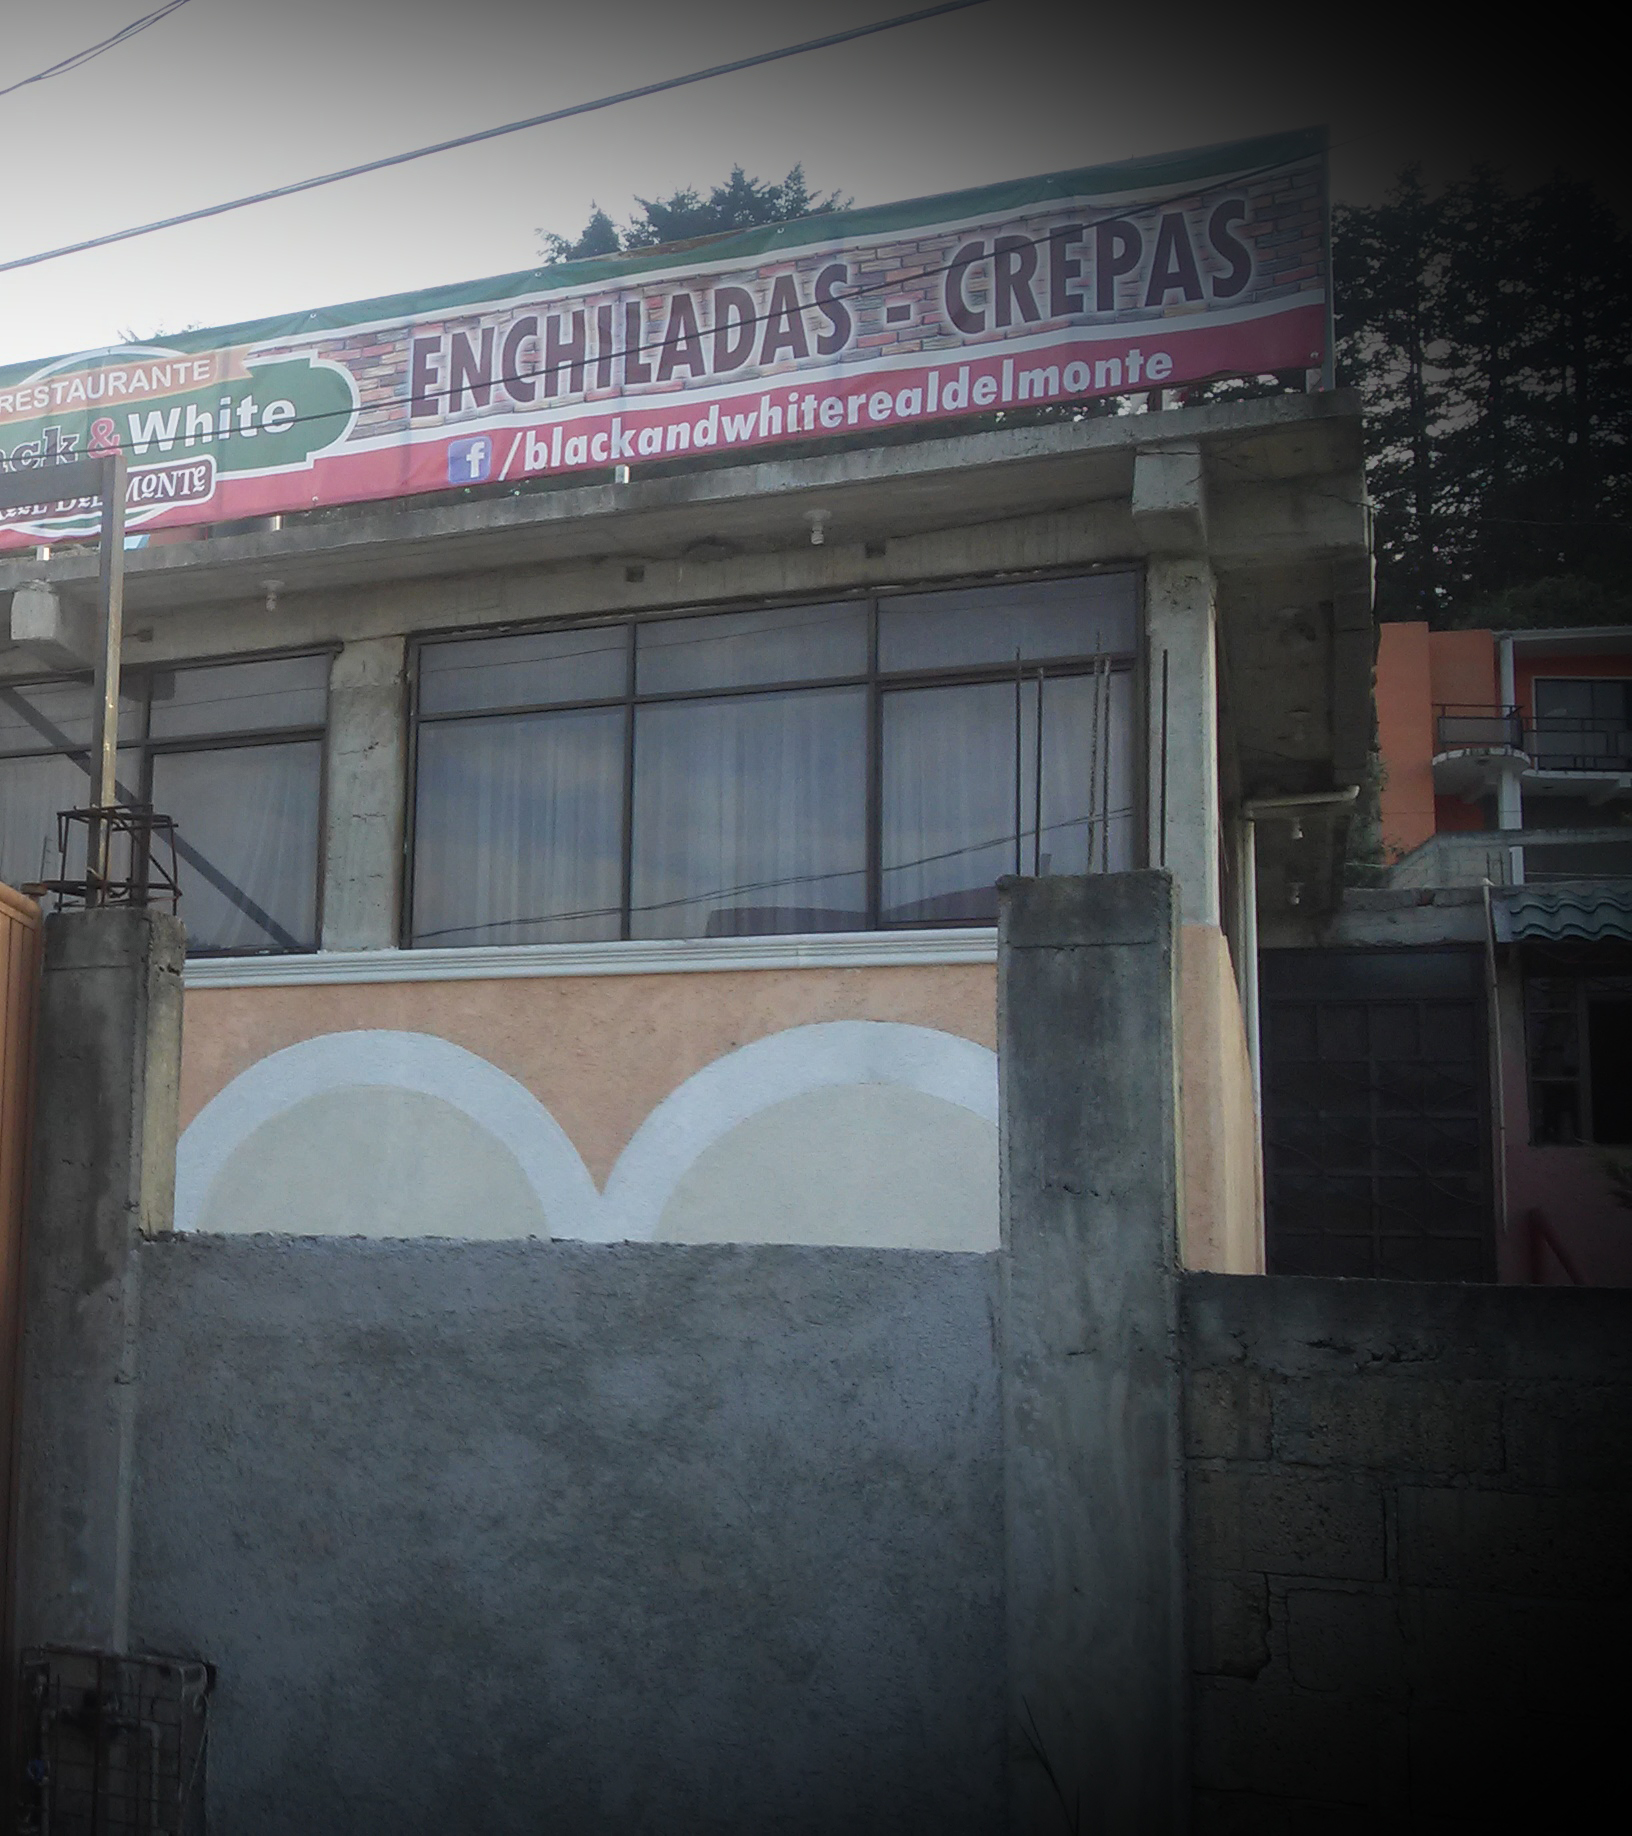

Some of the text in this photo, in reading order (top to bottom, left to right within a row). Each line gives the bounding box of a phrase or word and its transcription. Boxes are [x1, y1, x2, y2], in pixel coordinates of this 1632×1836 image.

[411, 264, 853, 418] ENCHILADAS
[945, 199, 1253, 334] CREPAS
[87, 417, 123, 459] &
[128, 396, 296, 455] White
[499, 348, 1173, 481] /blackandwhiterealdelmonte
